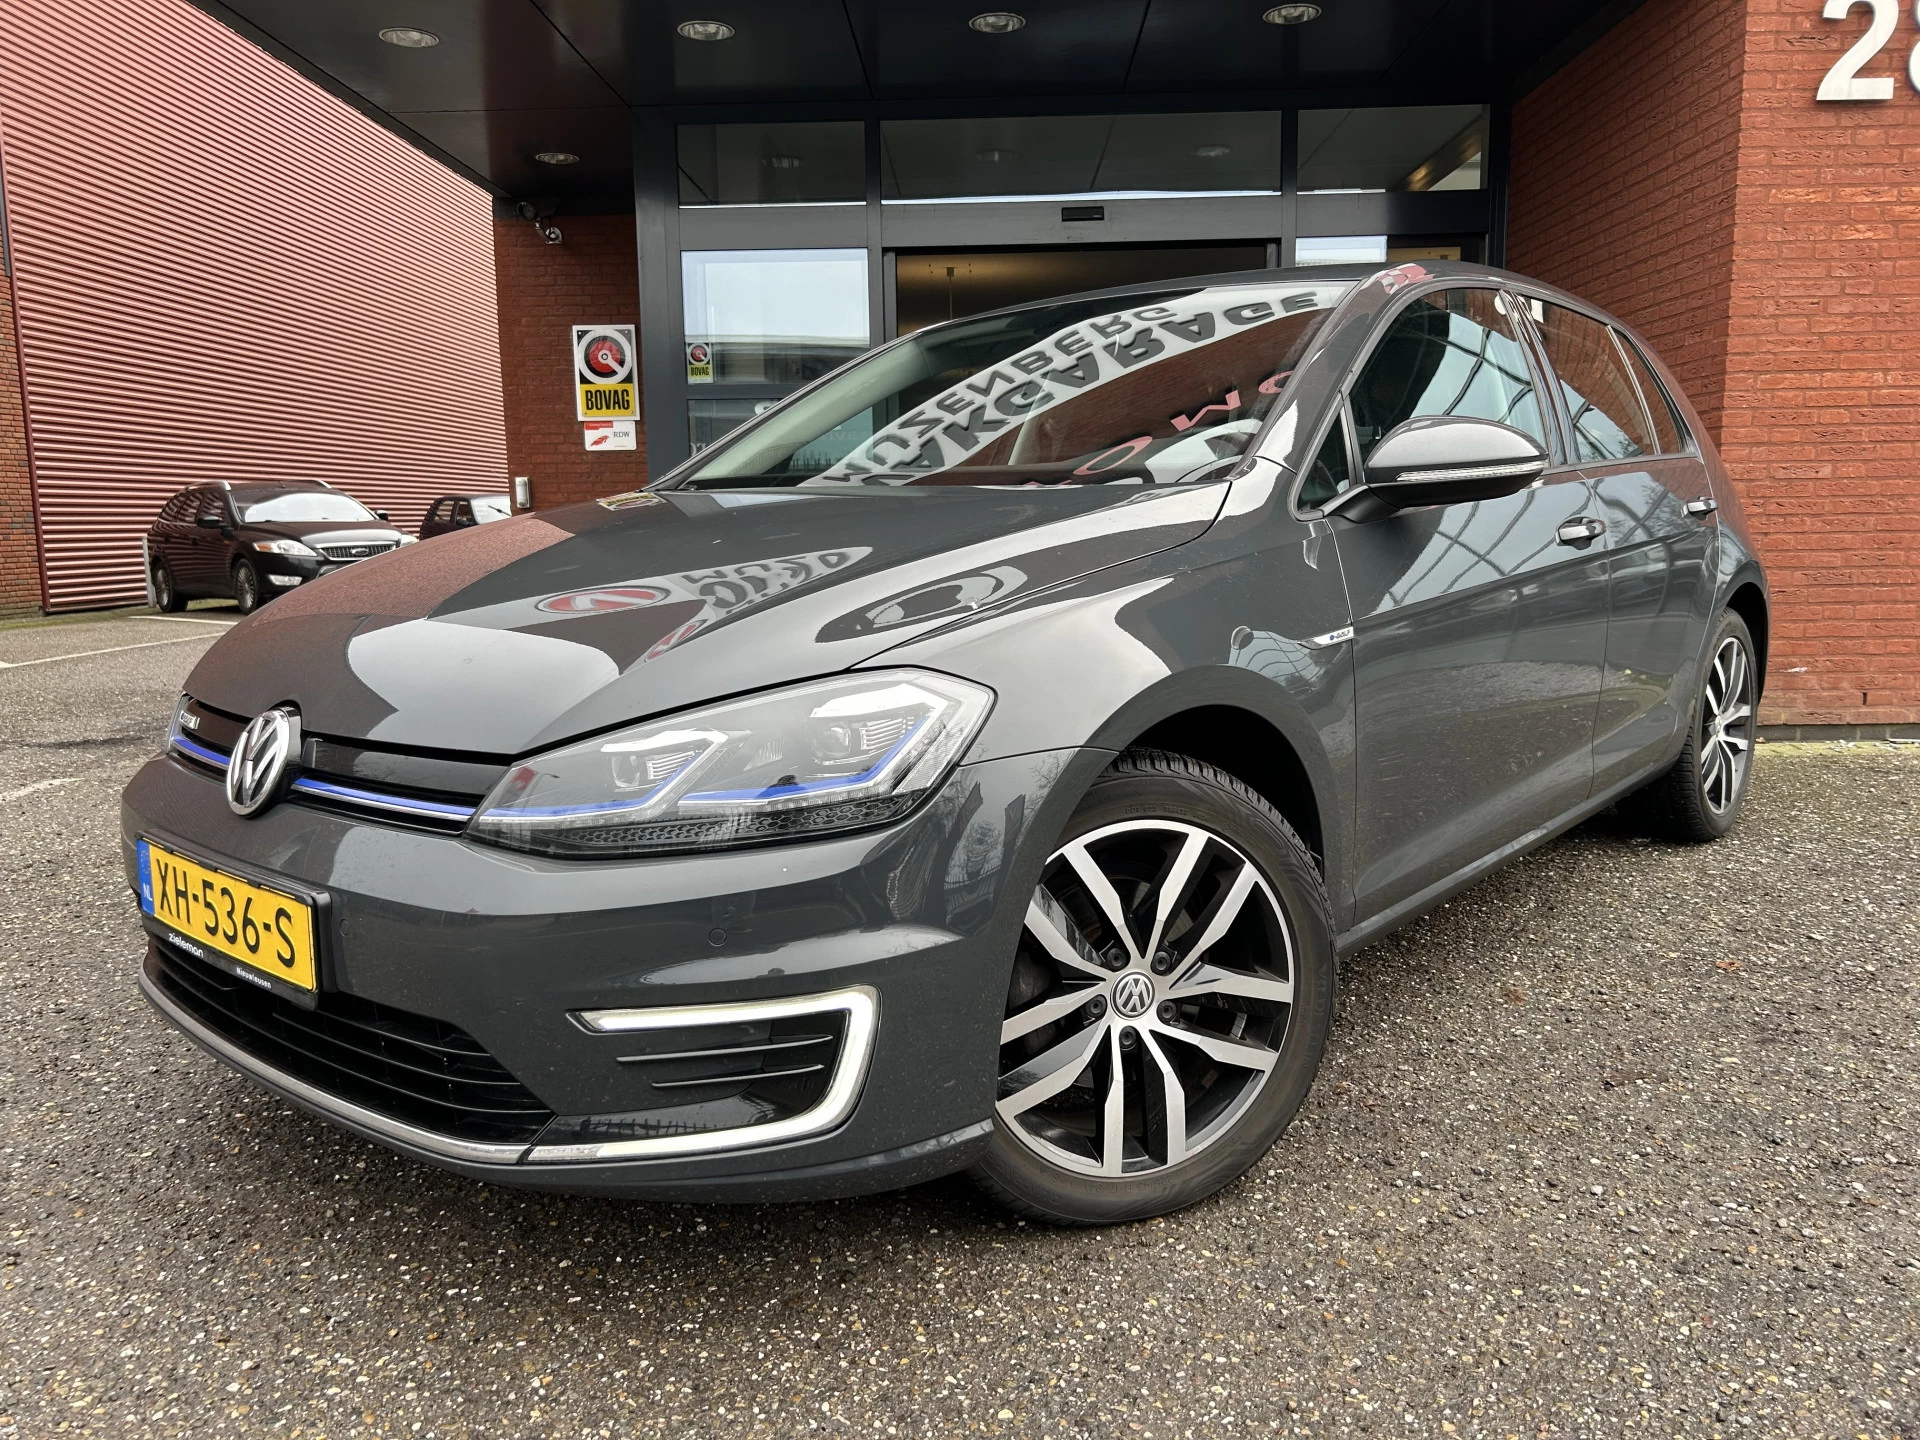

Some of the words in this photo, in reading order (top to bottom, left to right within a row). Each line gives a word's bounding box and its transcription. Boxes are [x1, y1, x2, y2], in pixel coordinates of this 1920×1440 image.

[1816, 0, 1920, 100] 2
[690, 367, 710, 376] BOVAG
[585, 389, 630, 411] BOVAG
[142, 883, 153, 901] NL
[156, 858, 296, 968] XH-536-S
[168, 932, 204, 958] zieleman
[236, 966, 272, 989] Nieuwleusen
